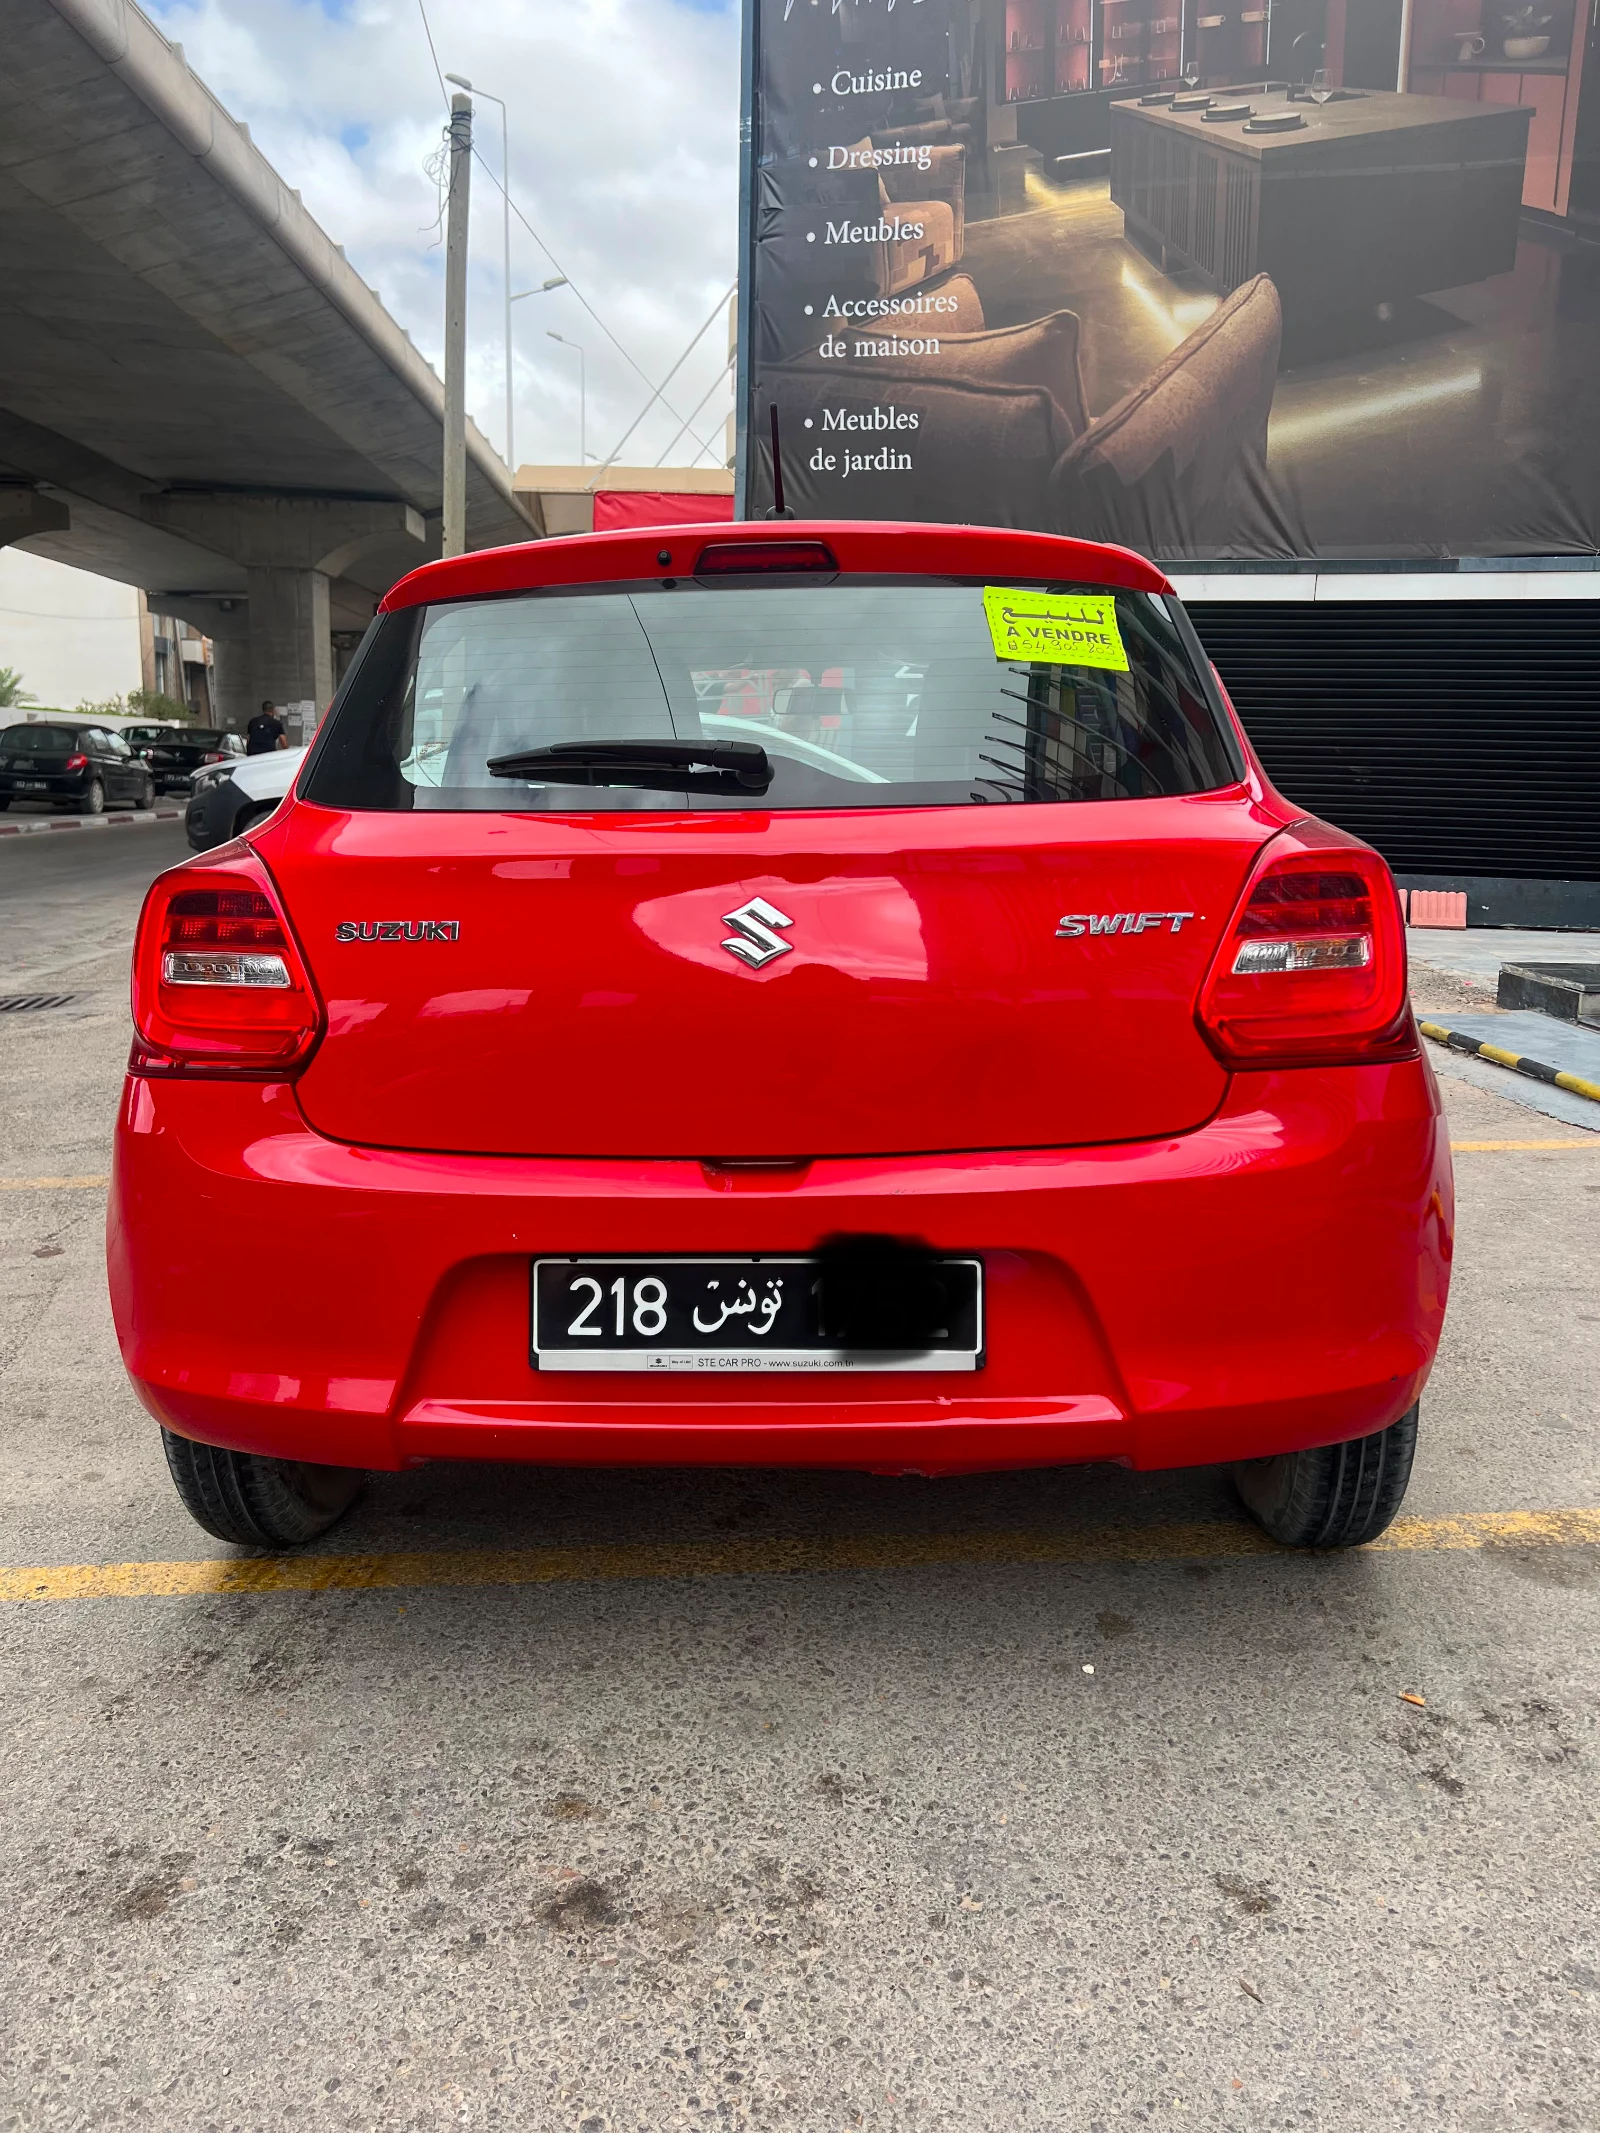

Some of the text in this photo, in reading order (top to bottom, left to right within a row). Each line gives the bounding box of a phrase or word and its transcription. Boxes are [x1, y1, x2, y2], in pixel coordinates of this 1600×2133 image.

[831, 67, 922, 96] Cuisine
[826, 141, 933, 171] Dressing
[824, 216, 924, 245] Meubles
[821, 291, 959, 318] Accessoires
[818, 334, 941, 359] de maison
[821, 406, 919, 432] Meubles
[809, 446, 913, 479] de jardin
[1001, 606, 1105, 627] للبيع
[1025, 626, 1113, 646] VENDRE
[335, 920, 460, 942] SUZUKI
[1054, 911, 1195, 937] SWIFT
[567, 1276, 669, 1337] 218
[692, 1276, 784, 1336] تونس
[697, 1357, 717, 1368] STE
[718, 1357, 739, 1368] CAR
[741, 1357, 762, 1368] PRO
[768, 1359, 854, 1368] www.suzuki.com.tn
